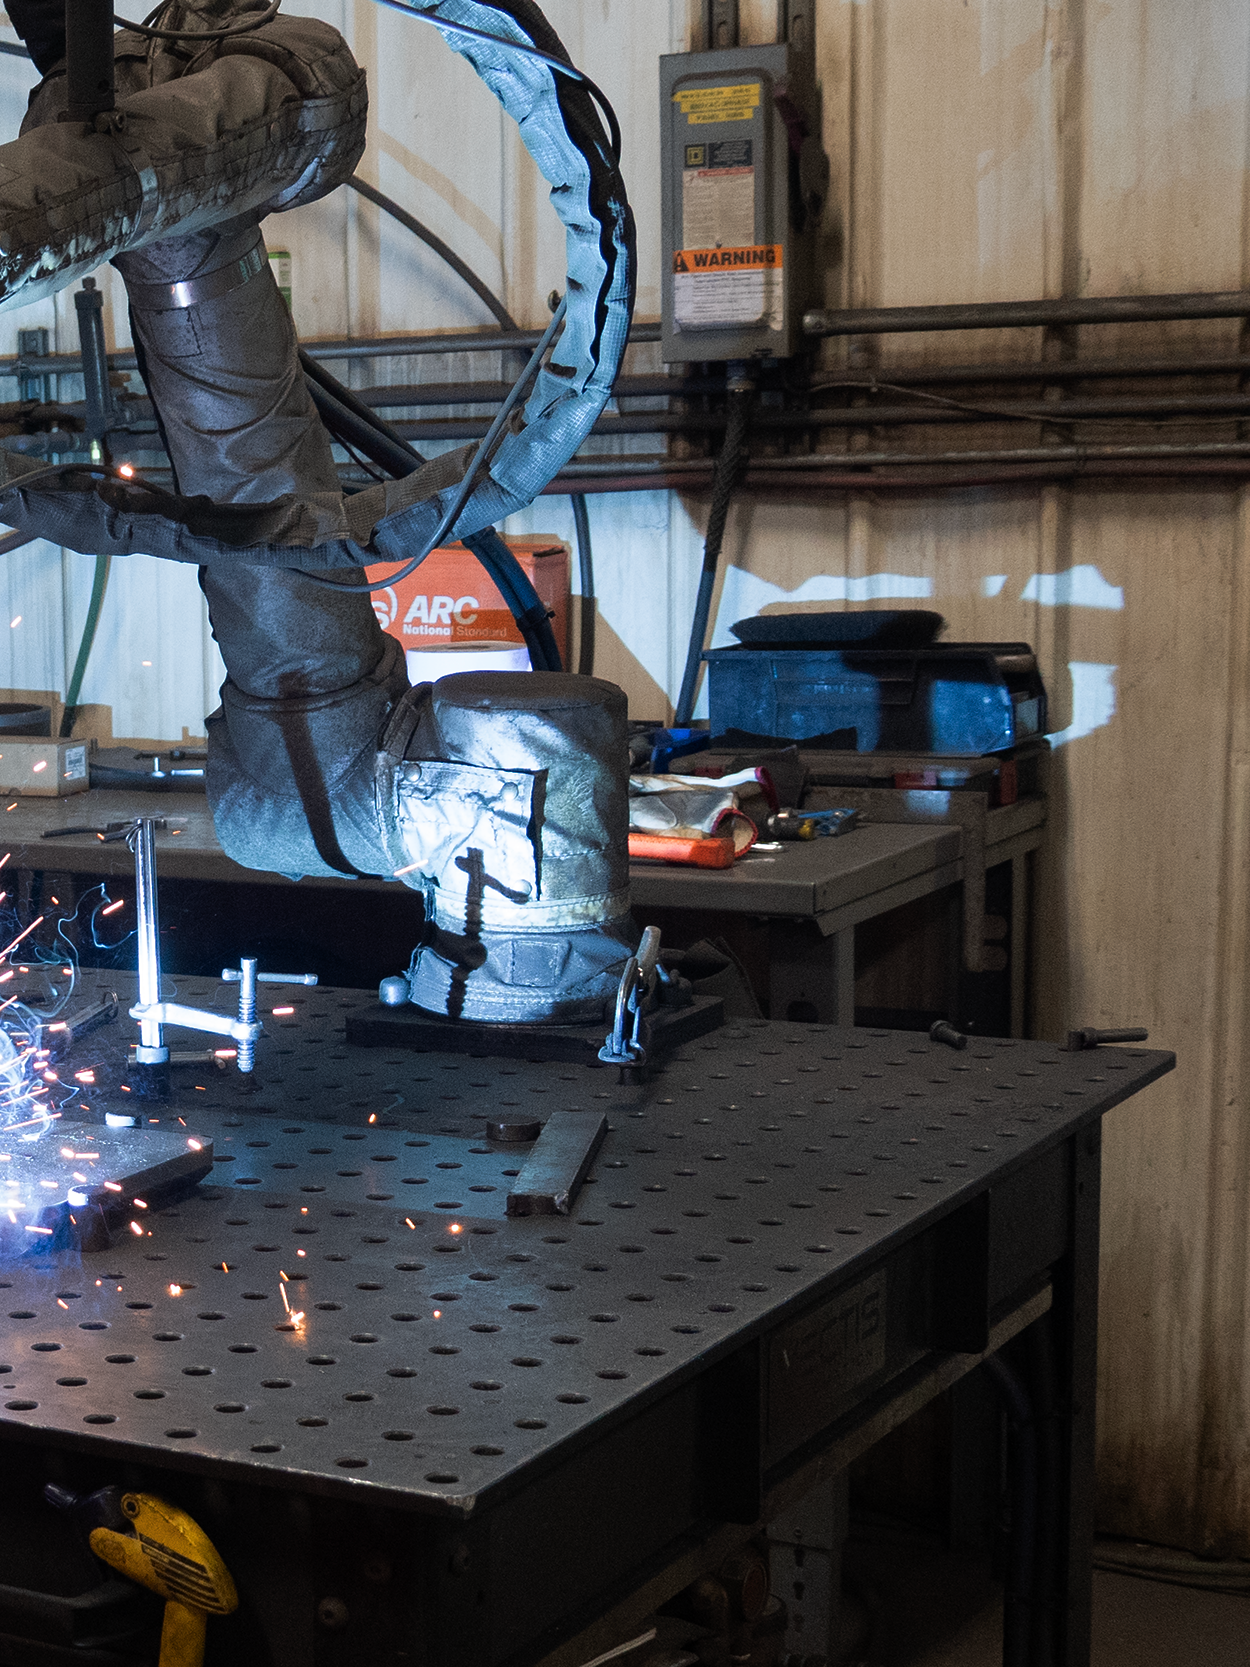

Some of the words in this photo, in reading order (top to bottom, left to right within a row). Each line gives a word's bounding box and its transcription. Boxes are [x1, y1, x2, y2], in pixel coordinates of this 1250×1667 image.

[693, 249, 776, 268] WARNING
[403, 595, 480, 625] ARC
[403, 624, 454, 636] National
